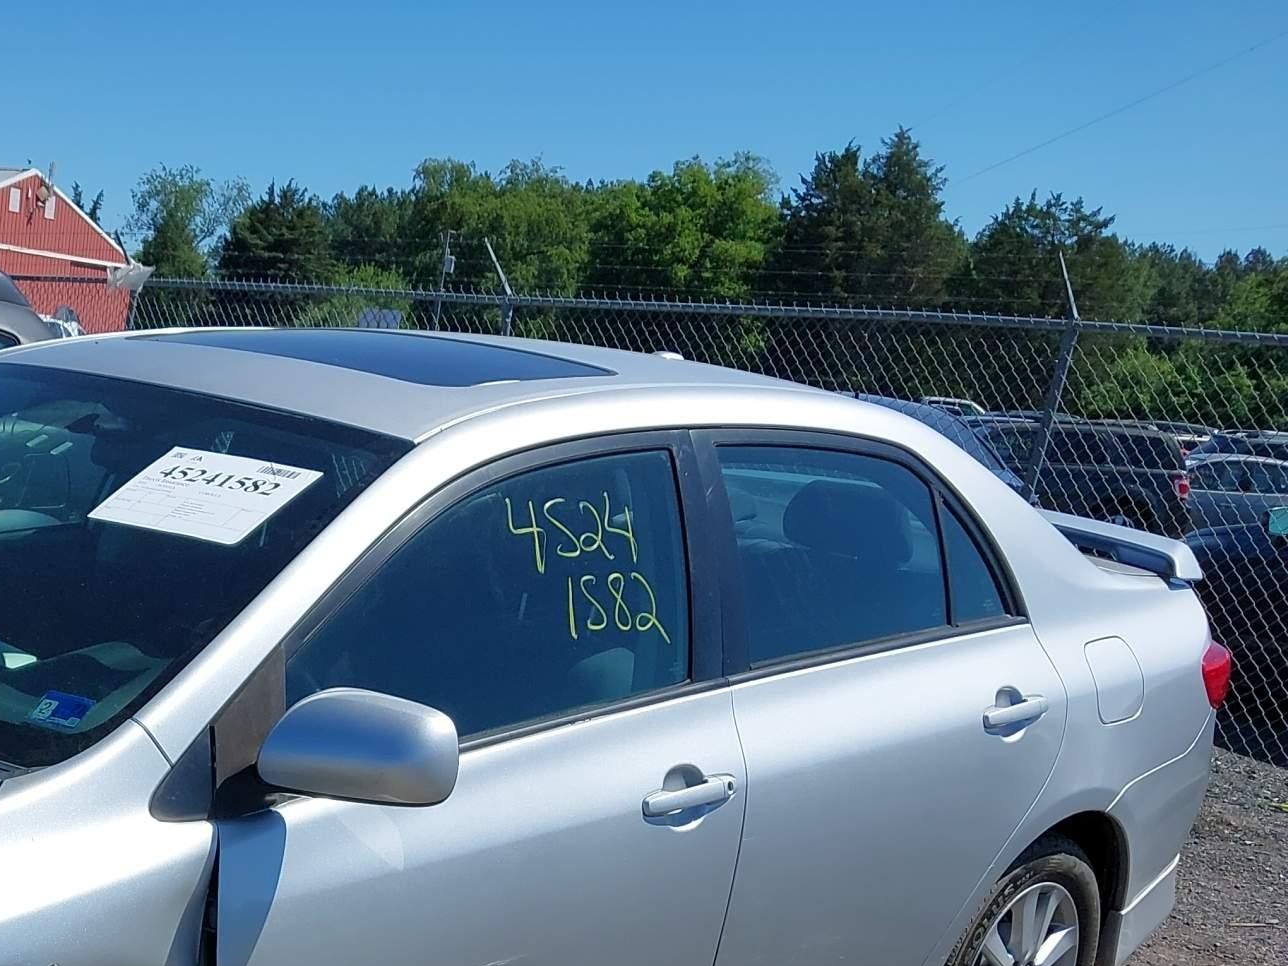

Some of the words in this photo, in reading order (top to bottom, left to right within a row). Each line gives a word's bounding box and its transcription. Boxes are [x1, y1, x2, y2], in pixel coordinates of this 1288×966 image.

[159, 465, 281, 496] 45241582
[505, 491, 638, 574] 4524
[568, 572, 671, 643] 1582
